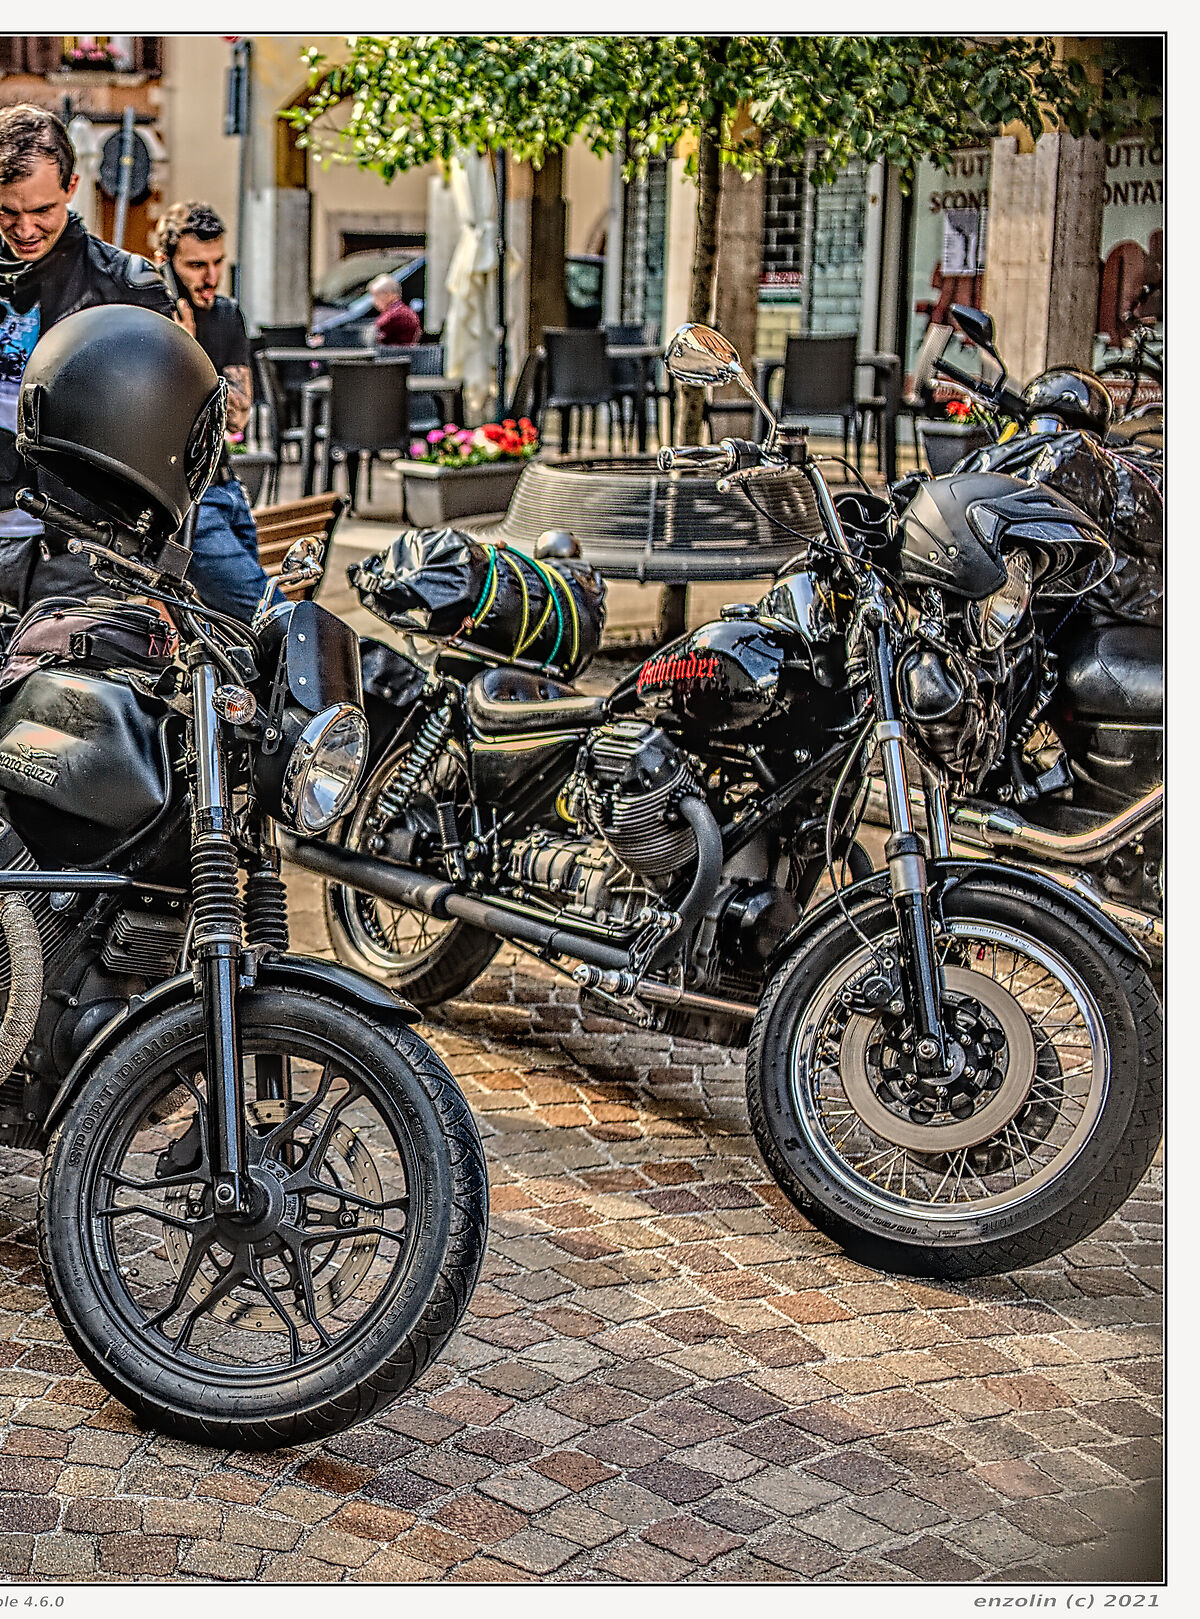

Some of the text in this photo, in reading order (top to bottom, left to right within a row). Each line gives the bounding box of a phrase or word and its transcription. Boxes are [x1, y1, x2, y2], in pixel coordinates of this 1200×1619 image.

[23, 762, 59, 788] GUZZI
[69, 1021, 192, 1167] SPORT DEMON
[335, 1277, 418, 1375] PIRELLI
